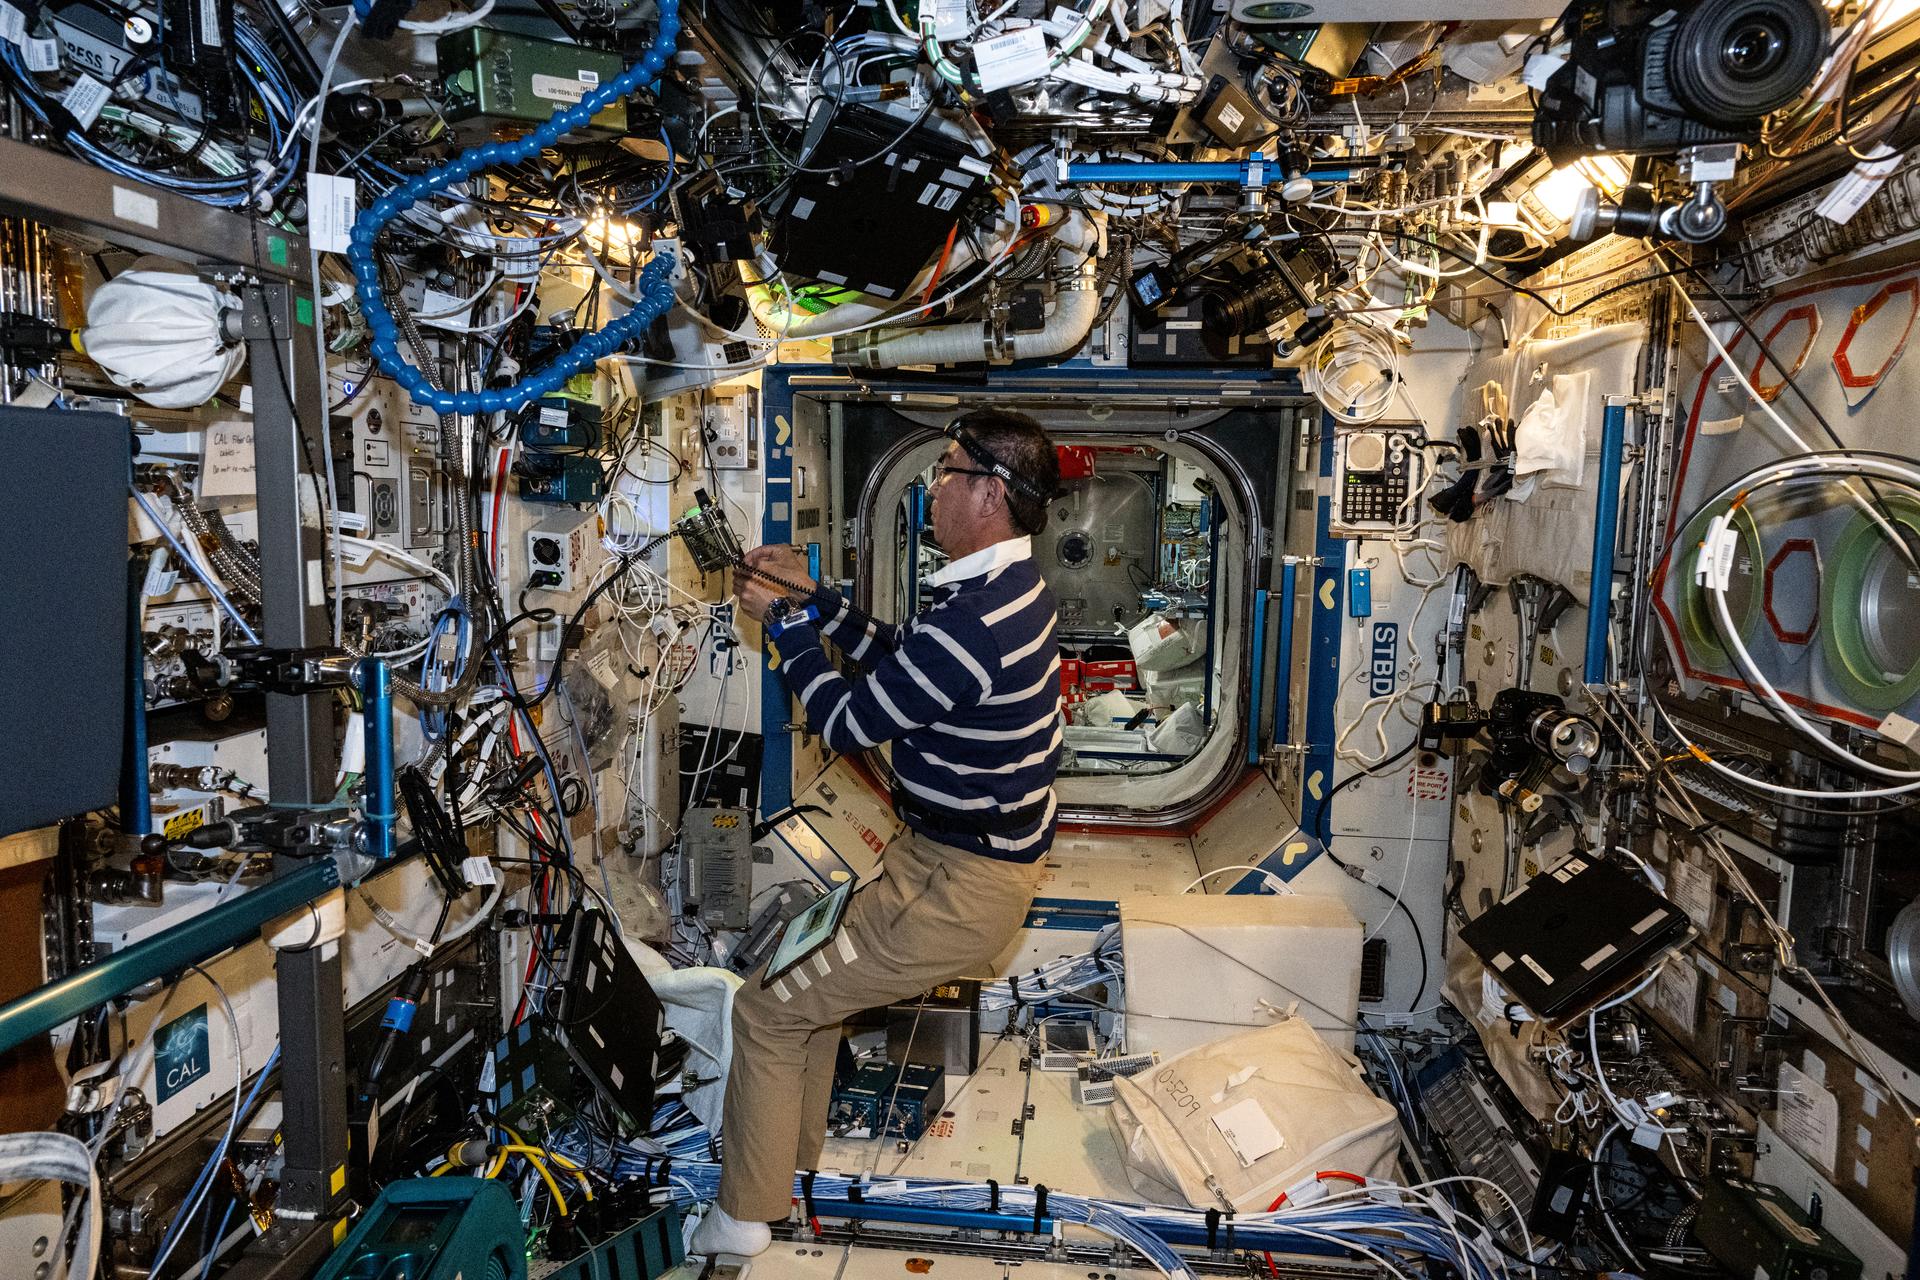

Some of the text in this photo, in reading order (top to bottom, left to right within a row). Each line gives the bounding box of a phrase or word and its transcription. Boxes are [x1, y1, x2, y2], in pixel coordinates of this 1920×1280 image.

[110, 55, 120, 77] 7
[214, 433, 228, 446] CAL
[993, 464, 1011, 480] PETZL
[1373, 626, 1396, 696] STBD
[1427, 782, 1442, 790] PORT
[166, 1058, 201, 1088] CAL
